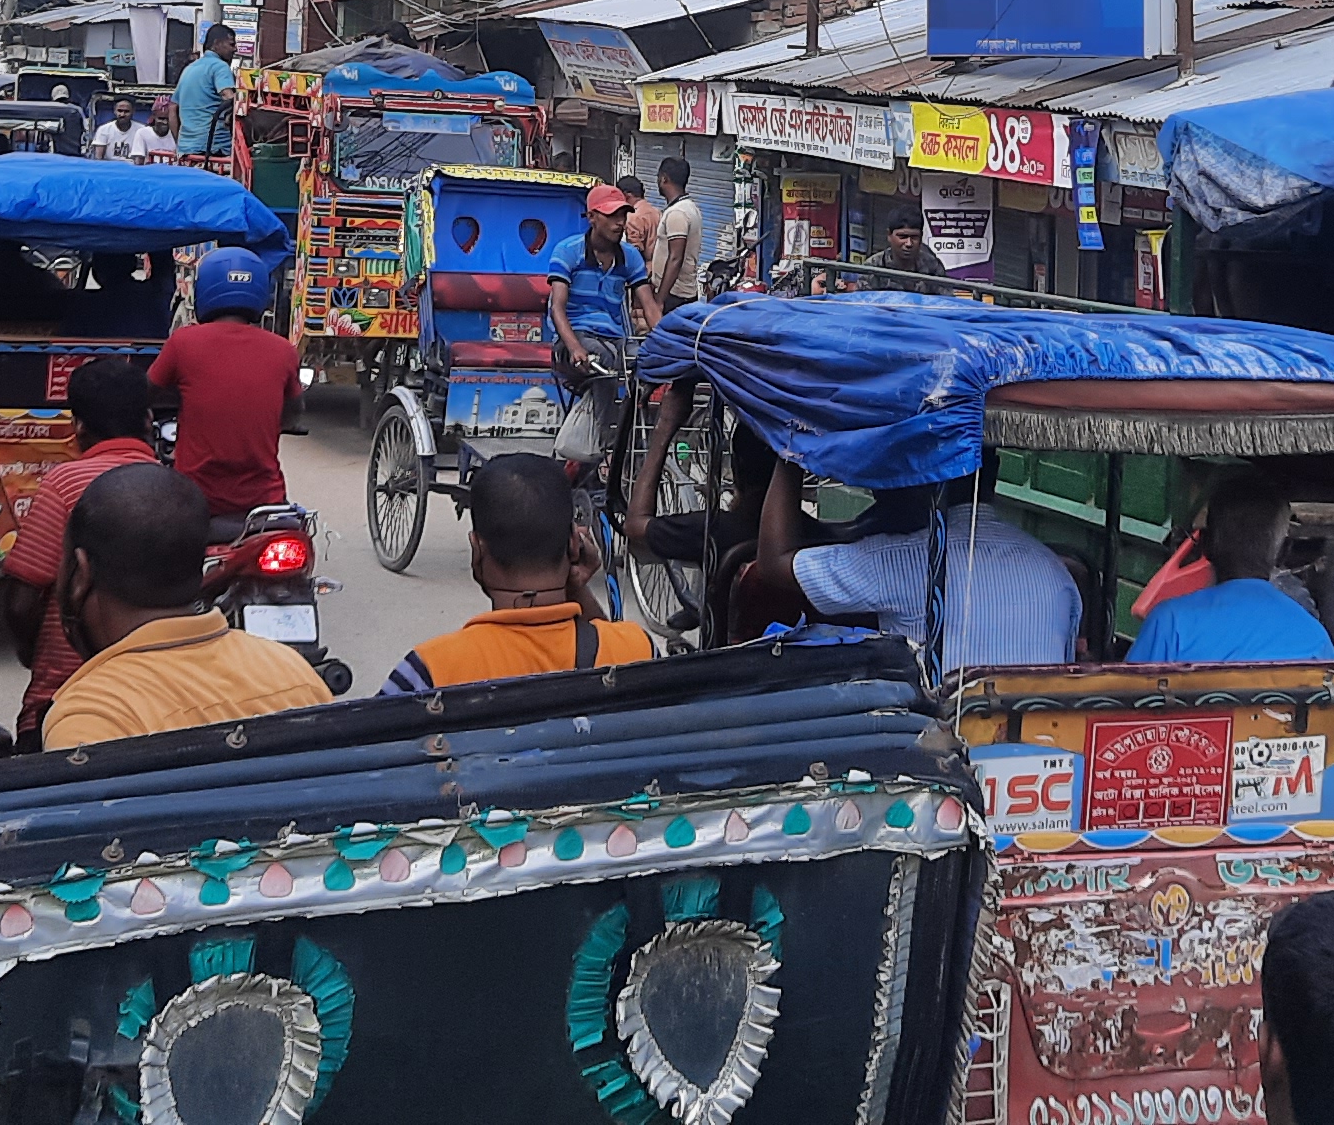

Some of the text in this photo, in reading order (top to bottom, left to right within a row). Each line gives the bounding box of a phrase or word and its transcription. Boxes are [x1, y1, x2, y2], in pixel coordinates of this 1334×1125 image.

[737, 98, 769, 137] মেসার্স
[942, 134, 980, 161] কমলো
[933, 238, 965, 252] রকেট
[228, 272, 251, 282] TVS
[1042, 758, 1064, 769] TMT
